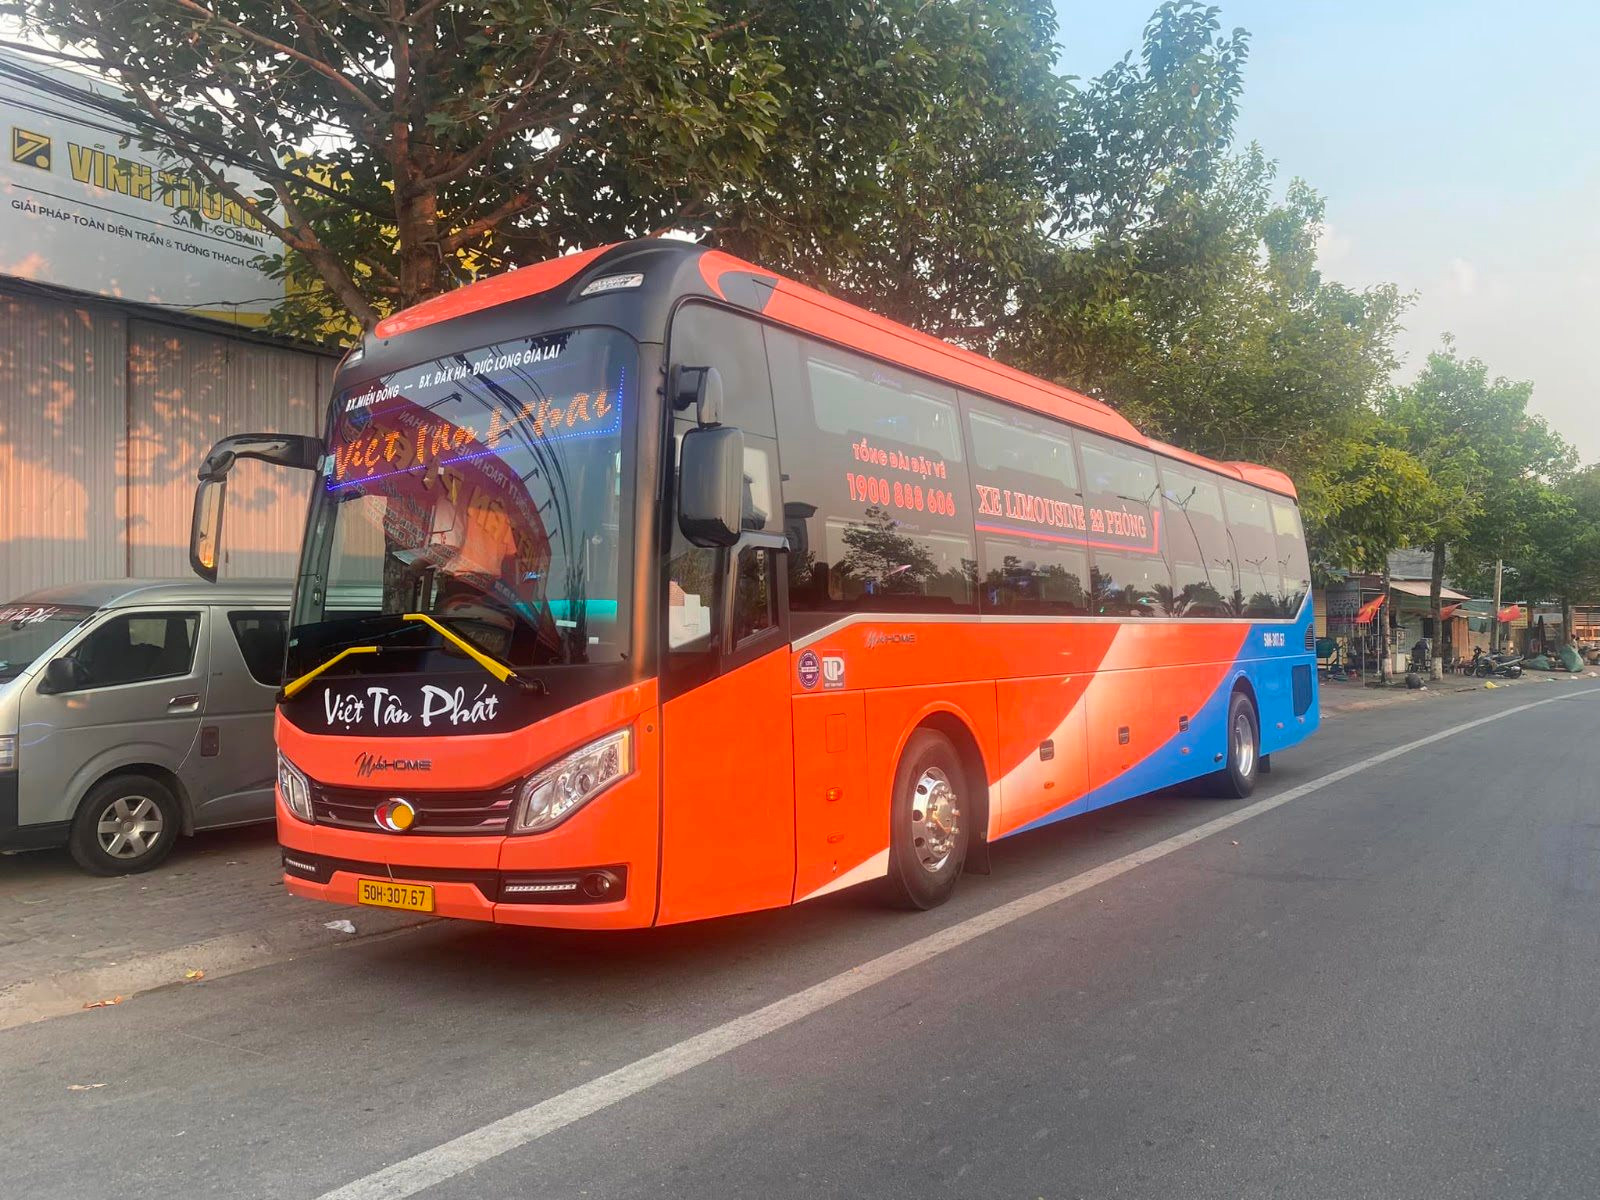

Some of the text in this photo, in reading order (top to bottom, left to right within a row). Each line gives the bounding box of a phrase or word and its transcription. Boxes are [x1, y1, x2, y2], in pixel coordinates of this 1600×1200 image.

[11, 199, 36, 214] GIẢI
[38, 205, 71, 221] PHÁP
[72, 214, 105, 231] TOÀN
[107, 224, 133, 239] DIỆN
[165, 239, 173, 248] &
[211, 250, 245, 267] THẠCH
[472, 353, 494, 376] ĐỨC
[494, 352, 522, 371] LONG
[523, 348, 542, 364] GIA
[543, 343, 561, 360] LAI
[852, 437, 889, 467] TỔNG
[889, 450, 911, 472] ĐÀI
[910, 455, 932, 480] ĐẶT
[846, 472, 956, 517] 1900 888 606
[975, 484, 1003, 517] XE
[1003, 490, 1087, 531] LIMOUSINE
[1105, 504, 1148, 539] PHÒNG
[324, 683, 499, 730] Việt Tân Phát
[364, 884, 425, 906] 50H-307.67
